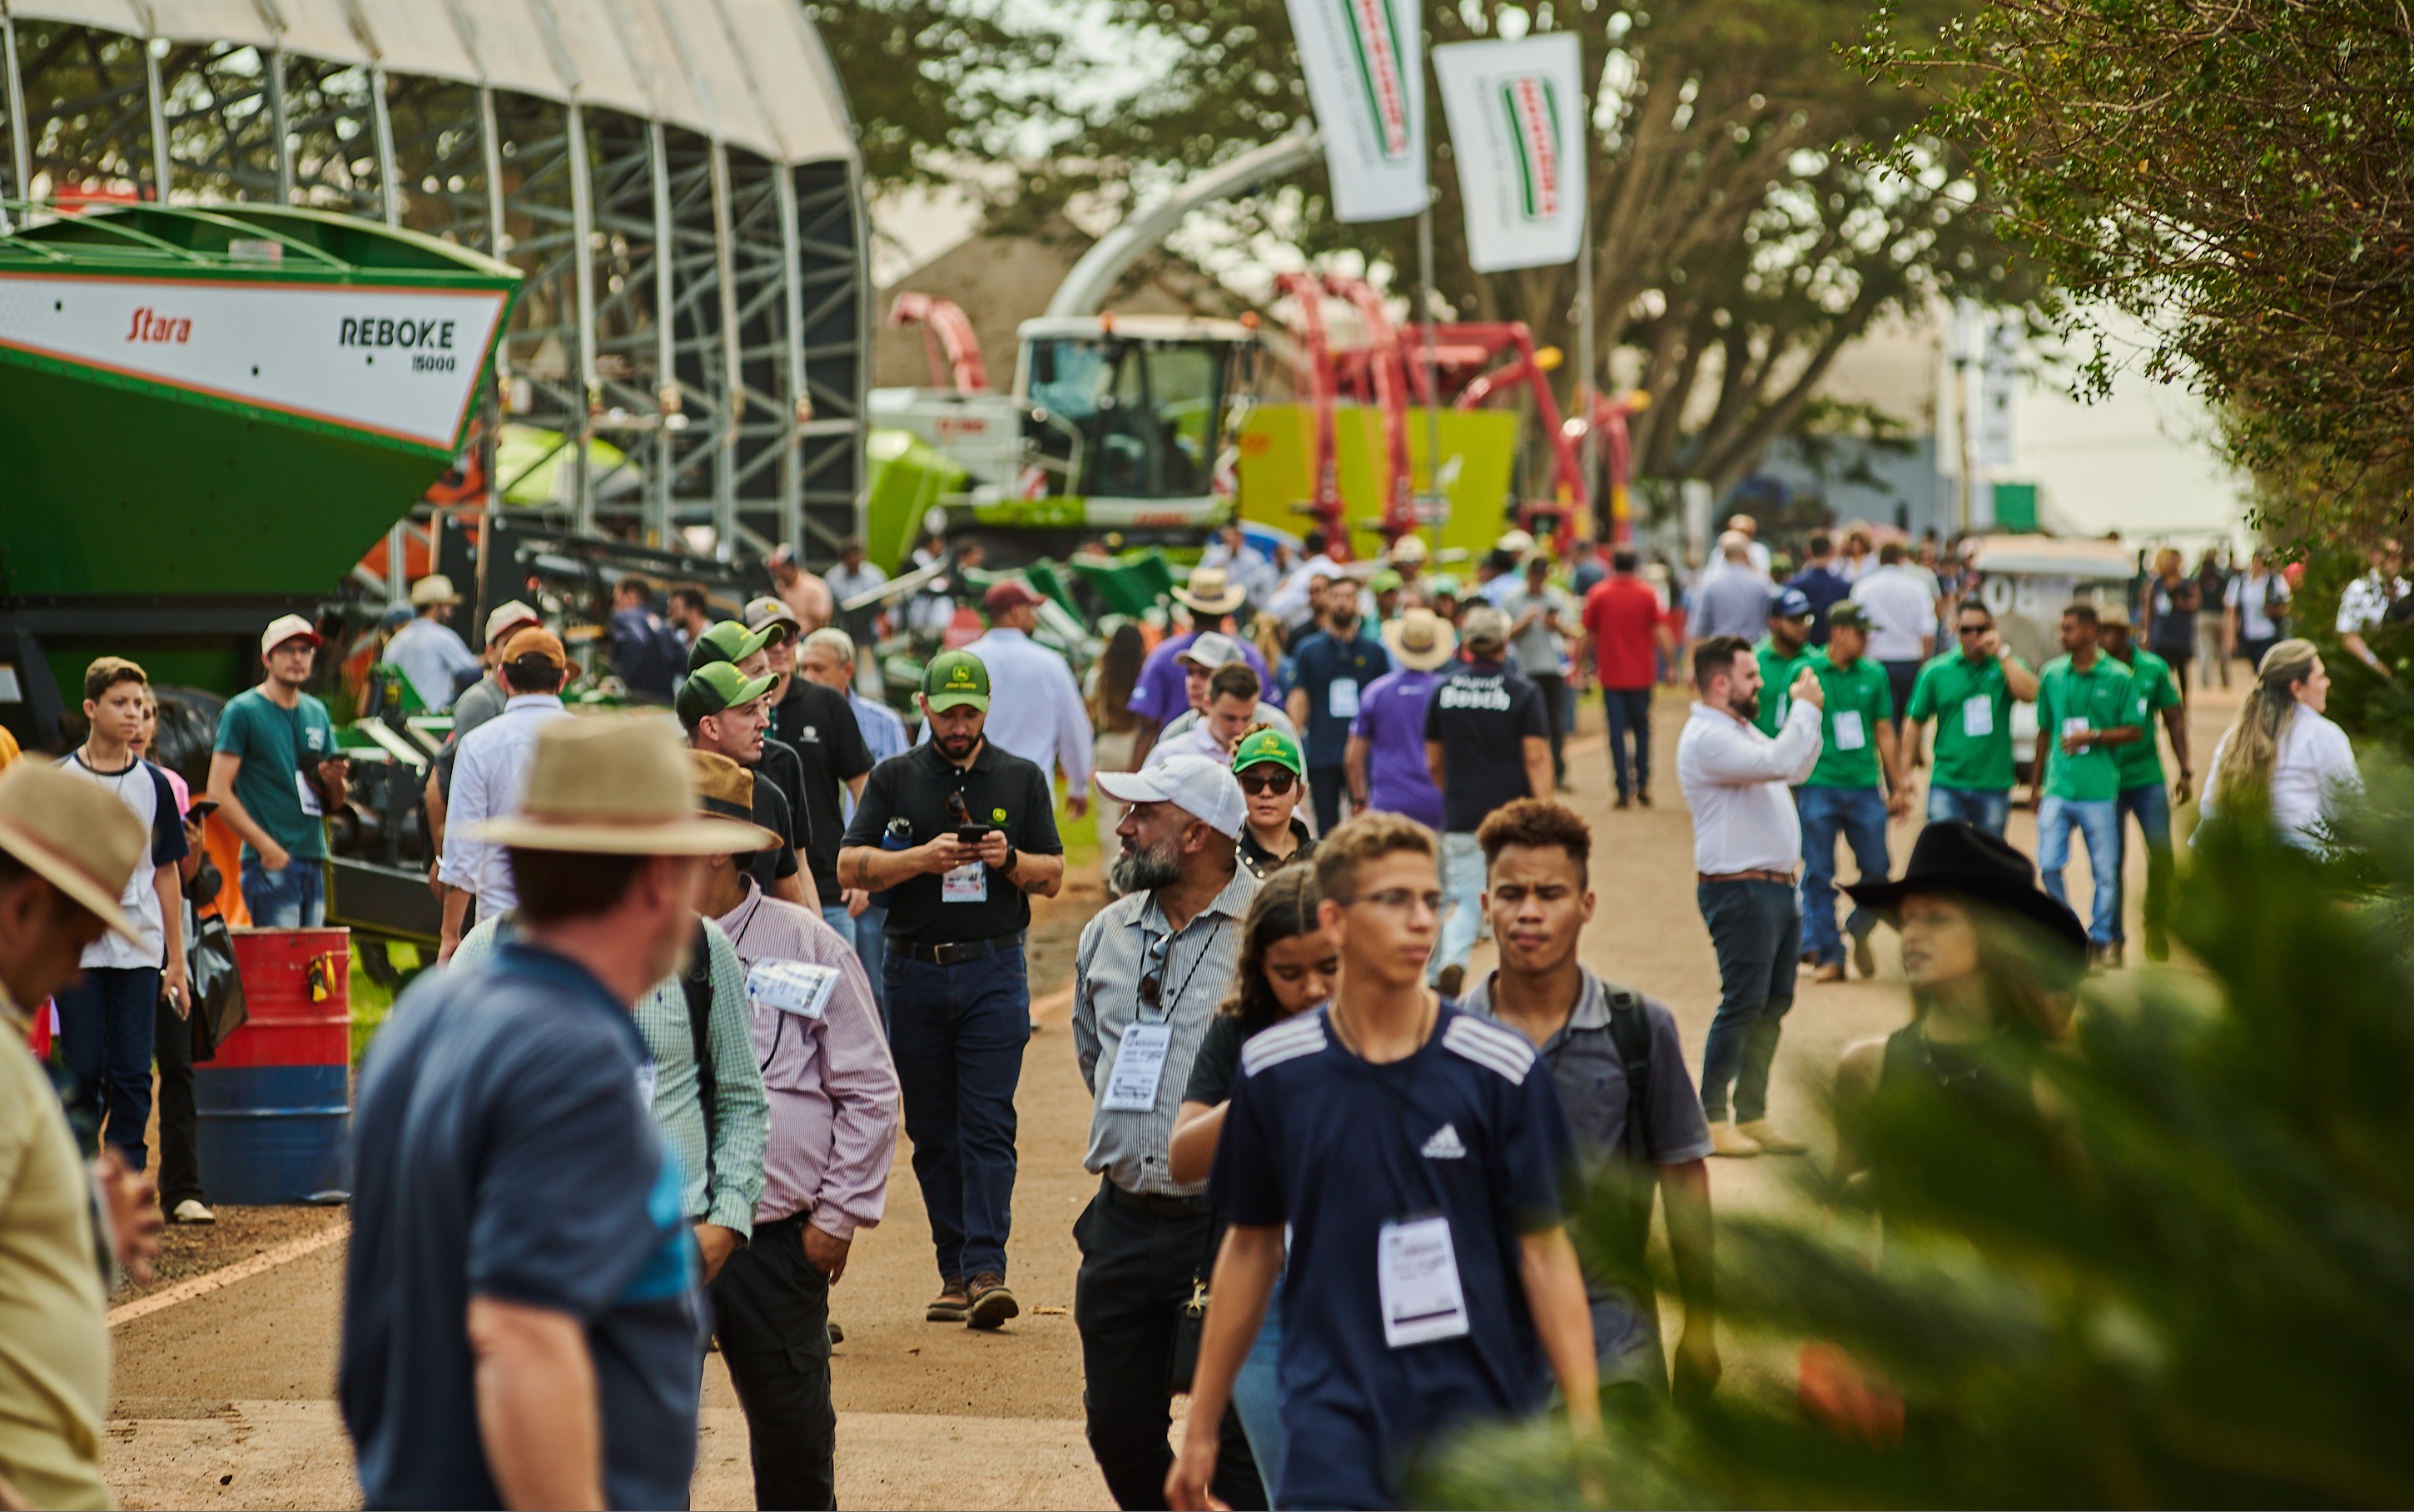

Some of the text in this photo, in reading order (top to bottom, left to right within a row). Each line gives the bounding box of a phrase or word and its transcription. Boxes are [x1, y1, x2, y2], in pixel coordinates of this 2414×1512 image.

[127, 307, 191, 343] Stara
[338, 317, 455, 349] REBOKE
[413, 354, 455, 372] 15000
